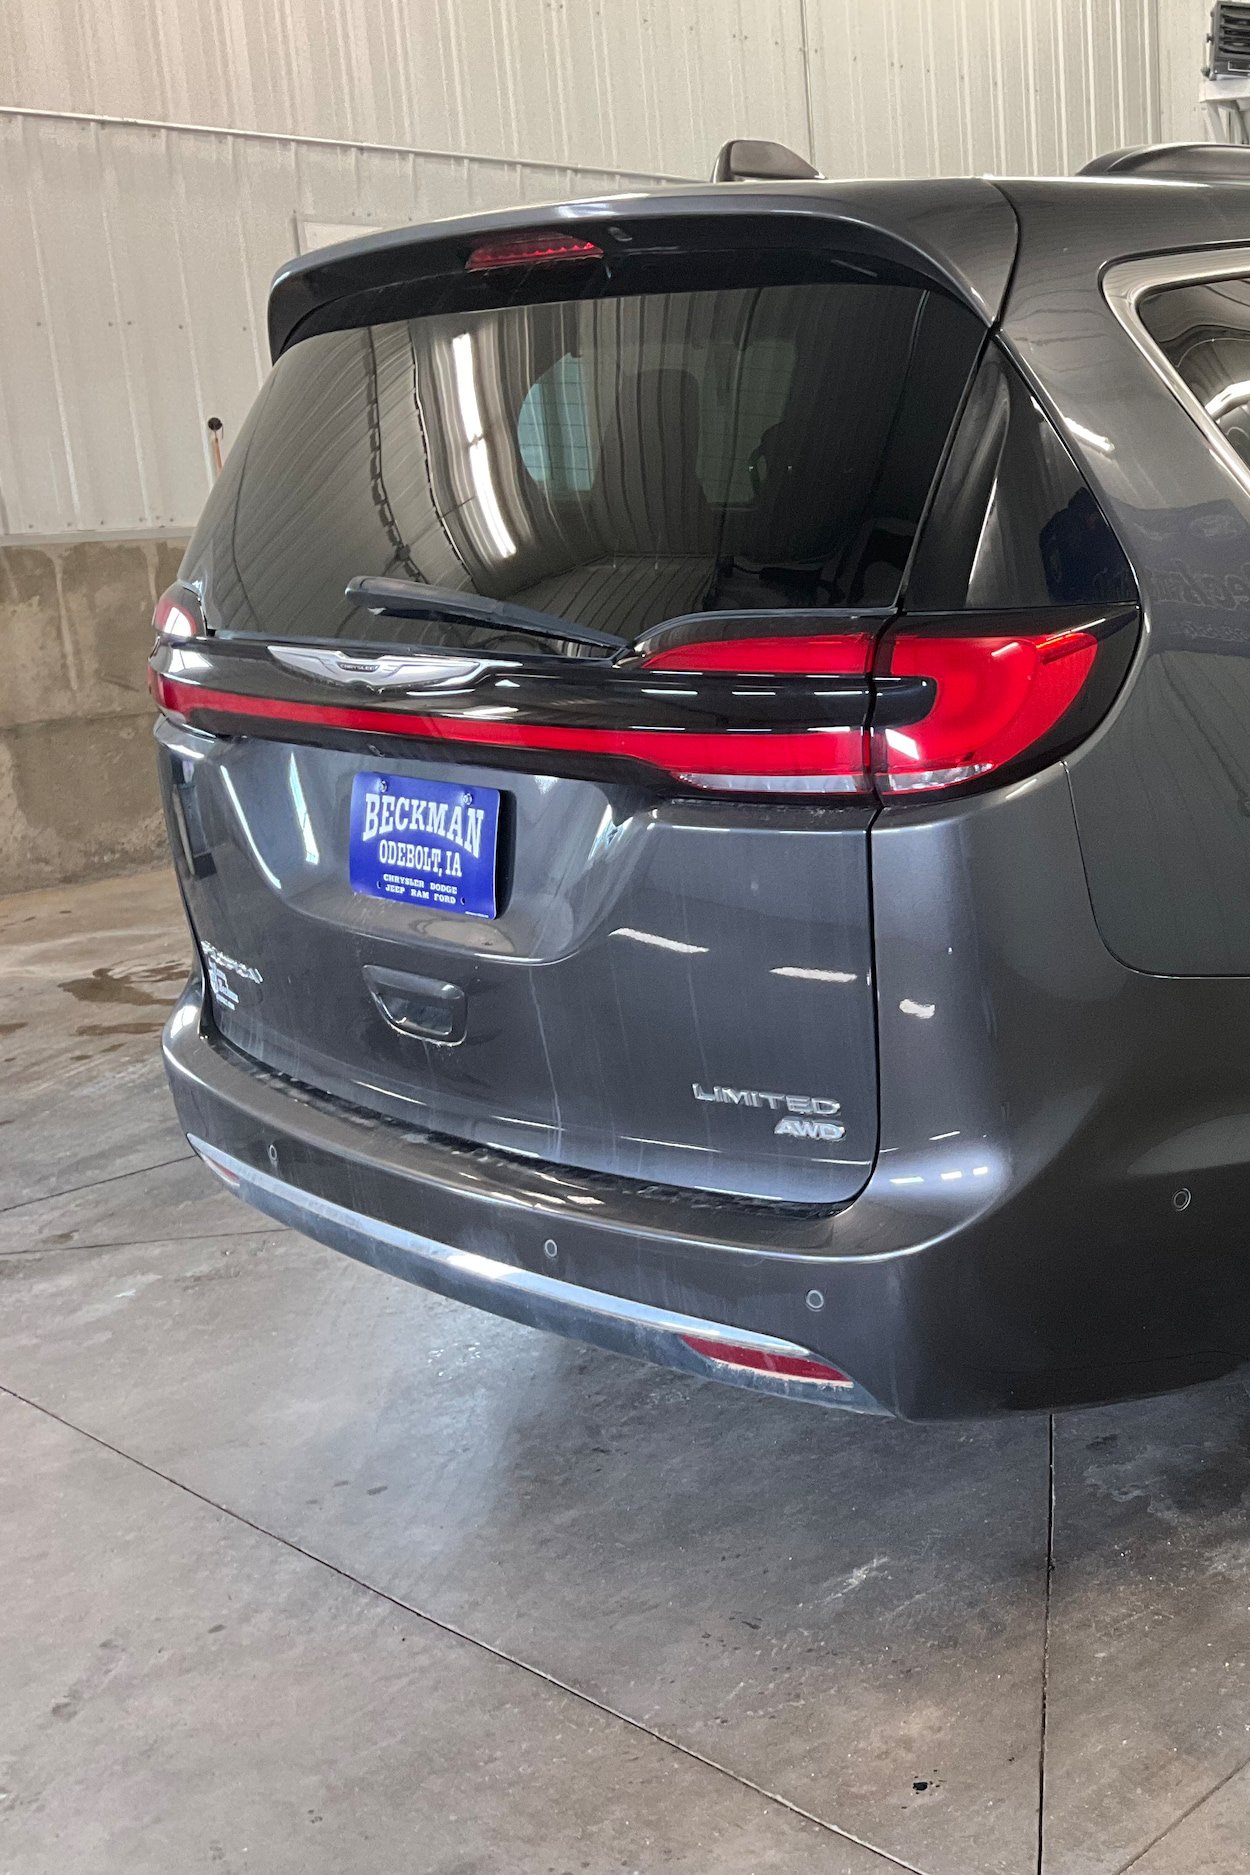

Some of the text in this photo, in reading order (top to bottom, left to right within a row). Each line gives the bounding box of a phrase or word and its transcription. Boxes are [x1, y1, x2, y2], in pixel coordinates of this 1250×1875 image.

[362, 793, 485, 859] BECKMAN
[379, 839, 463, 878] ODEBOLT, IA
[383, 873, 458, 895] CHRYSLER DODGE
[385, 884, 456, 905] JEEP RAM FORD
[692, 1083, 841, 1116] LIMITED
[774, 1116, 847, 1141] AWD
